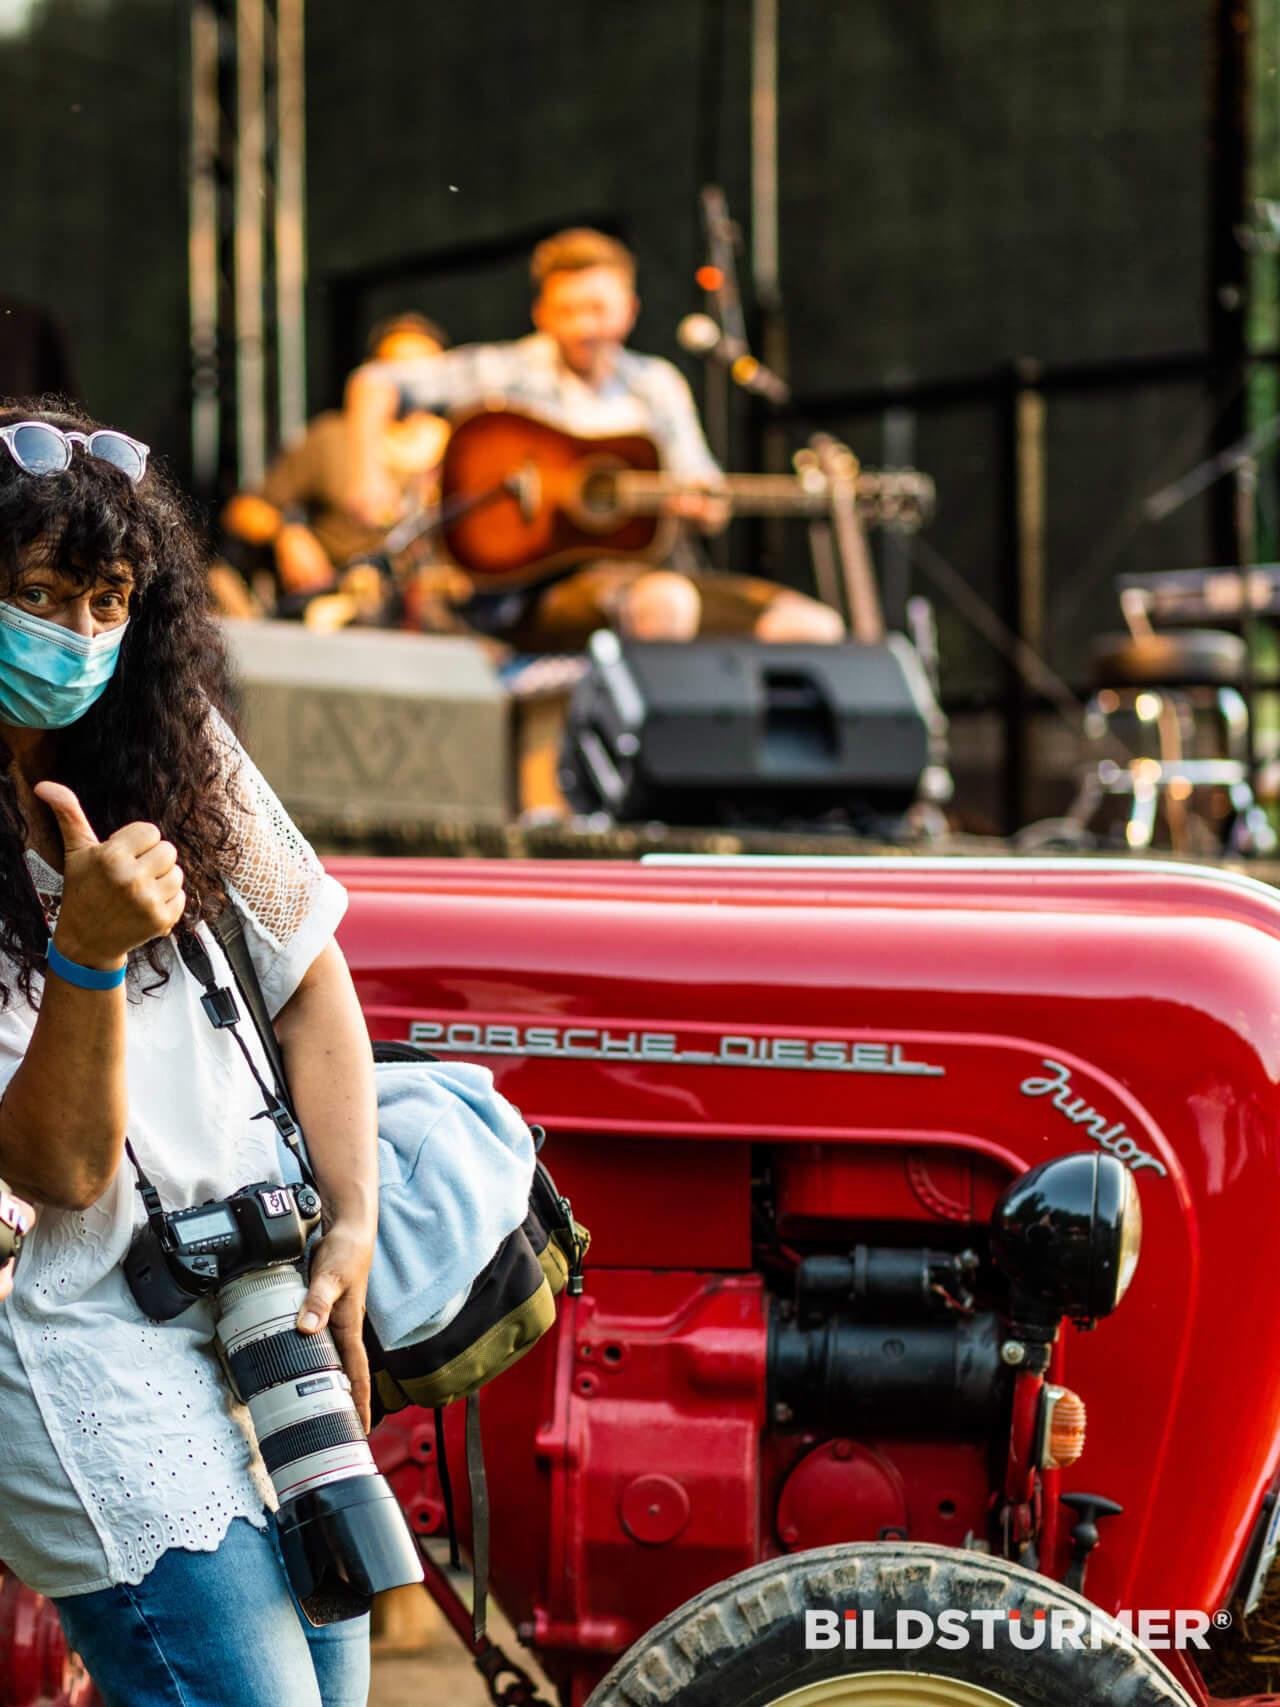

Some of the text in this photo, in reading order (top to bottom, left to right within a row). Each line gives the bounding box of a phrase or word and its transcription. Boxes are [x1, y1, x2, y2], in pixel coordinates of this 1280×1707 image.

[409, 1022, 929, 1073] PORSCHE DIESEL
[1020, 1059, 1167, 1177] Junior
